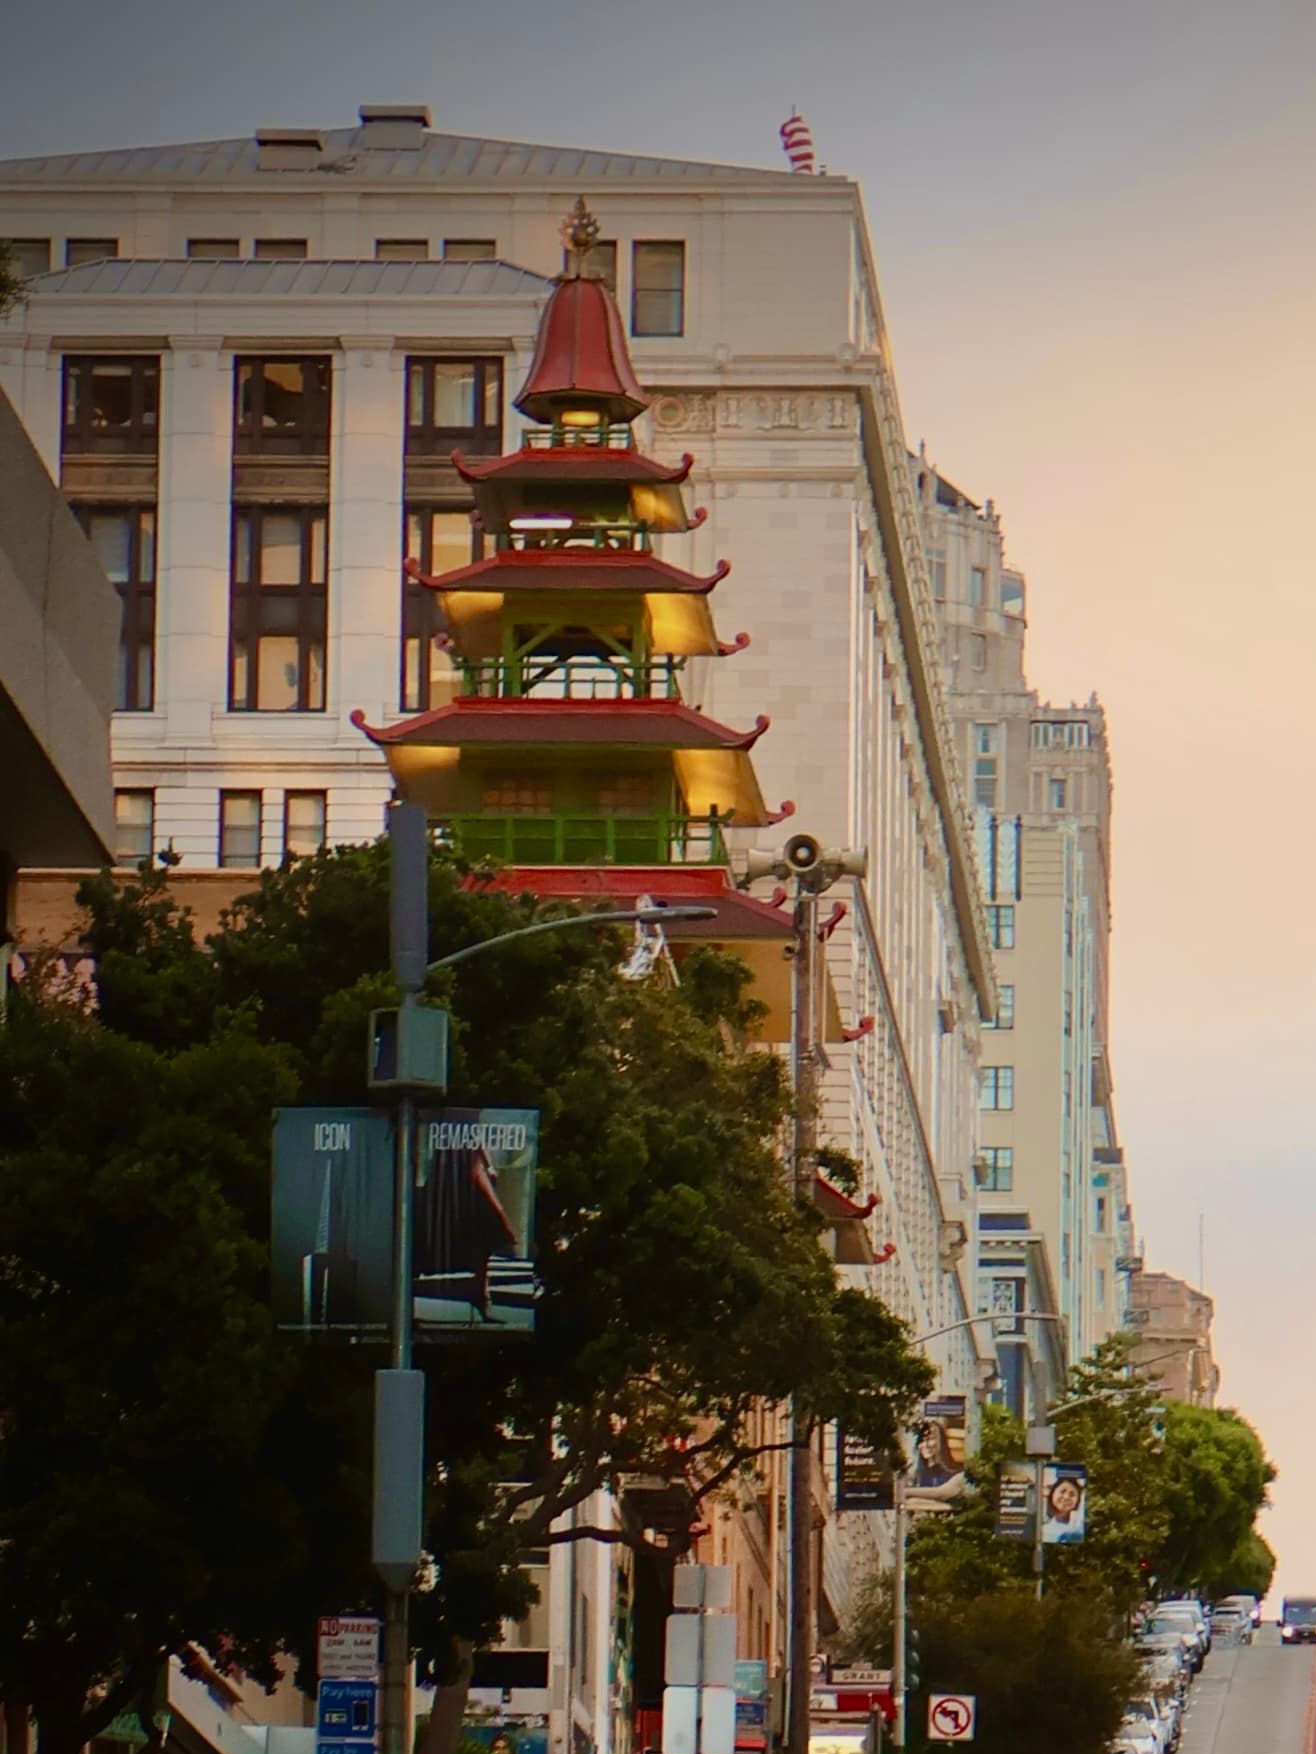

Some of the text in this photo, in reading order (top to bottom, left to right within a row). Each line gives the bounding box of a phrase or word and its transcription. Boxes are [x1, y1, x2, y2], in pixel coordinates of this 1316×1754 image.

[313, 1123, 351, 1152] ICON
[428, 1123, 526, 1151] REMASTERED
[320, 1620, 337, 1633] NO
[843, 1673, 880, 1681] GRANT
[321, 1686, 345, 1699] Pay
